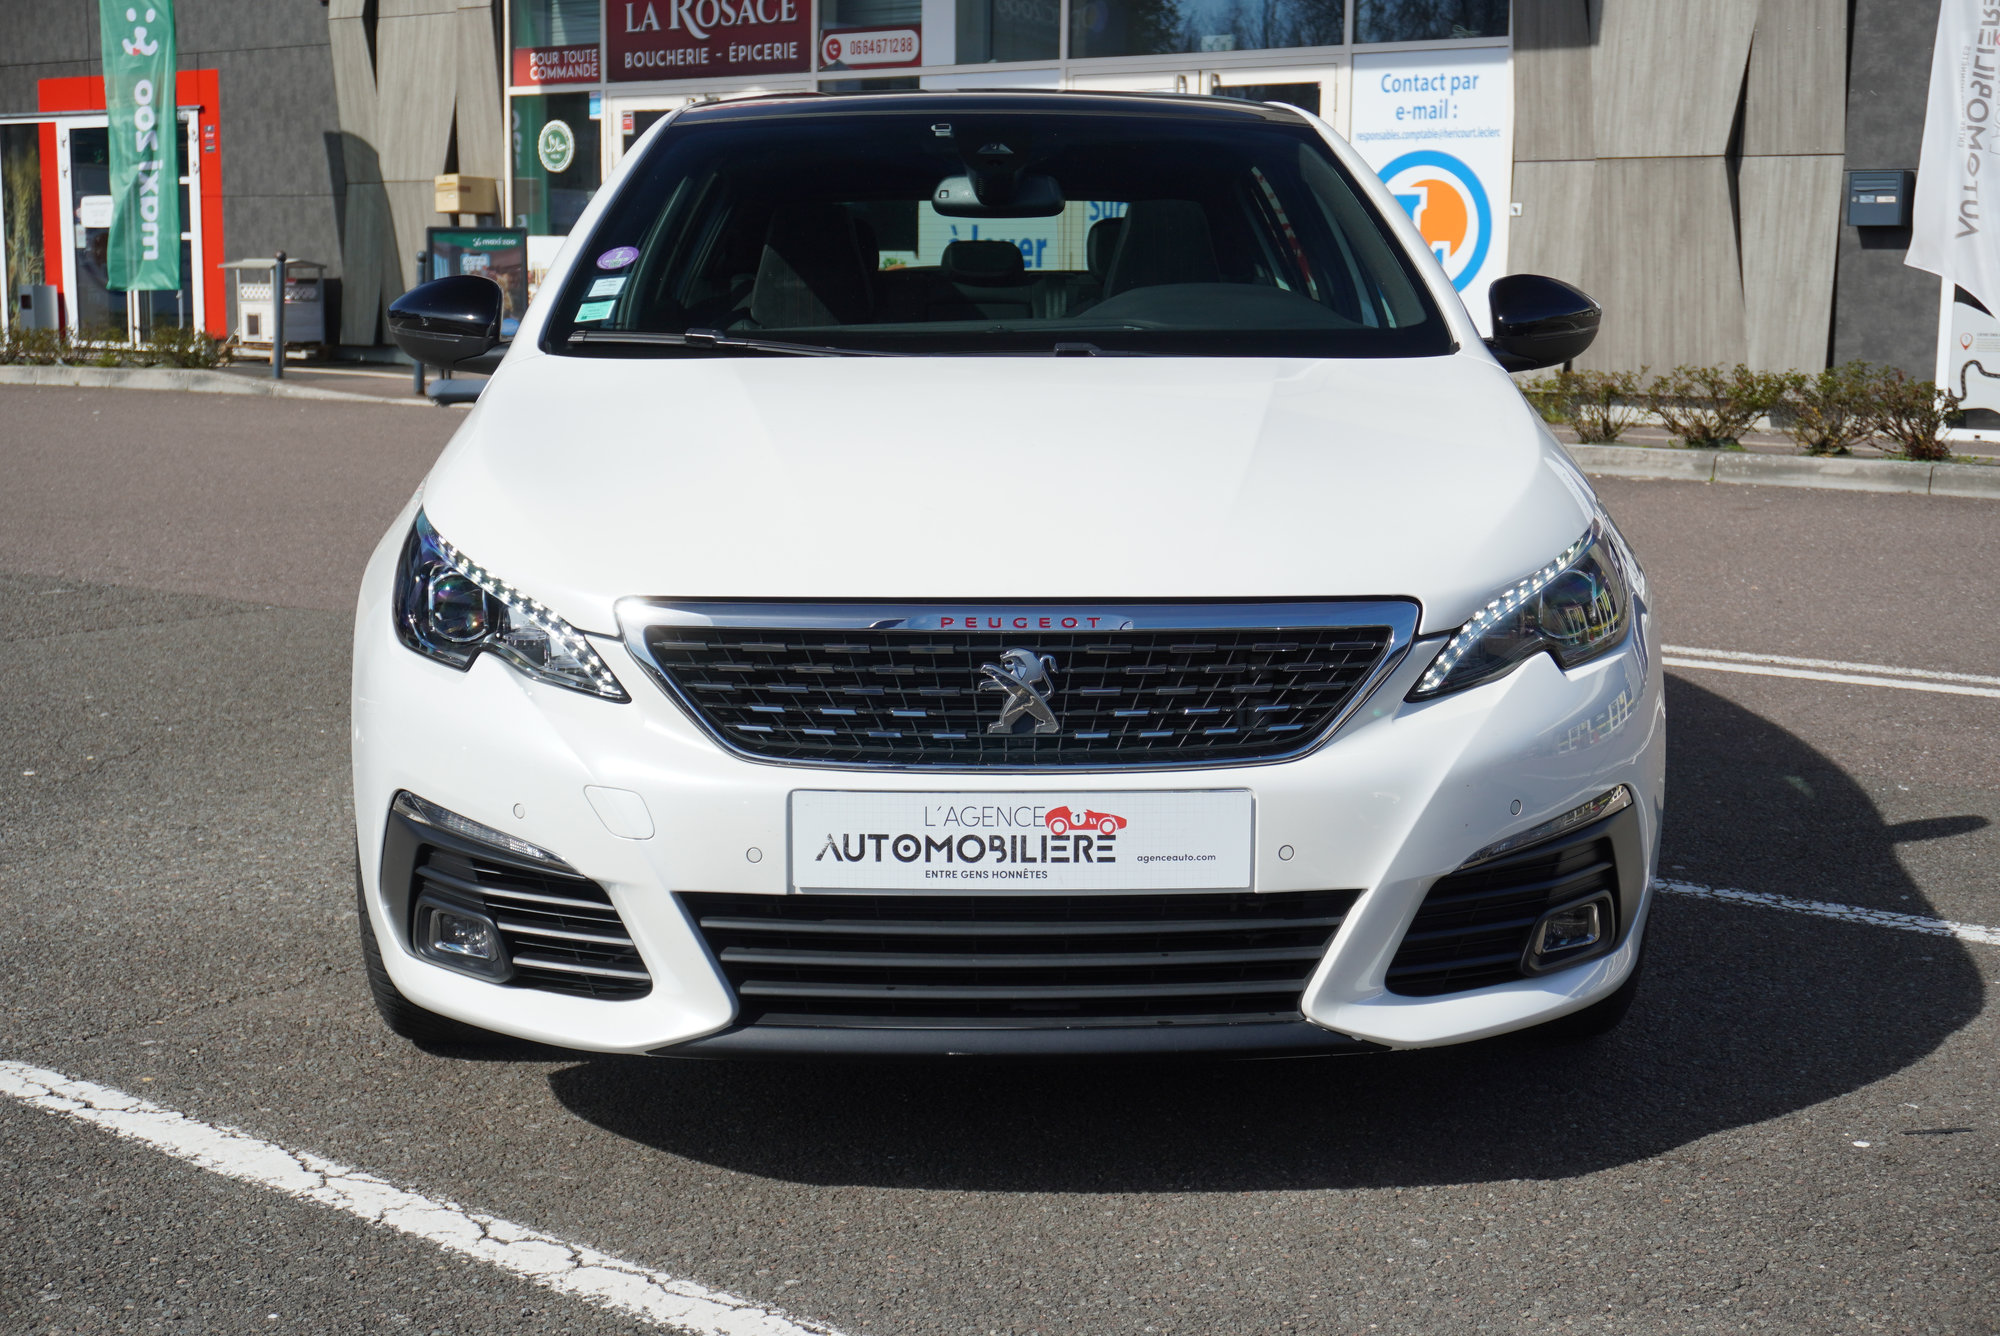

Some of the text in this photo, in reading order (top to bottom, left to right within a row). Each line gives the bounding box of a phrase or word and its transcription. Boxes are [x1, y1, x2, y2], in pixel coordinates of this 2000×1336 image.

[625, 0, 798, 39] LA ROSACE
[849, 37, 913, 55] 0664671288
[530, 49, 598, 66] POUR TOUTE
[624, 47, 710, 69] BOUCHERIE
[728, 42, 798, 62] ÉPICERIE
[530, 63, 598, 81] COMMANDE
[1381, 73, 1479, 96] Contact par
[1395, 98, 1449, 121] e-mail
[940, 617, 1101, 629] PEUGEOT
[925, 806, 1045, 827] L'AGENCE
[1136, 853, 1217, 864] agenceauto.com
[925, 867, 1048, 879] ENTRE GENS HONNÊTES
